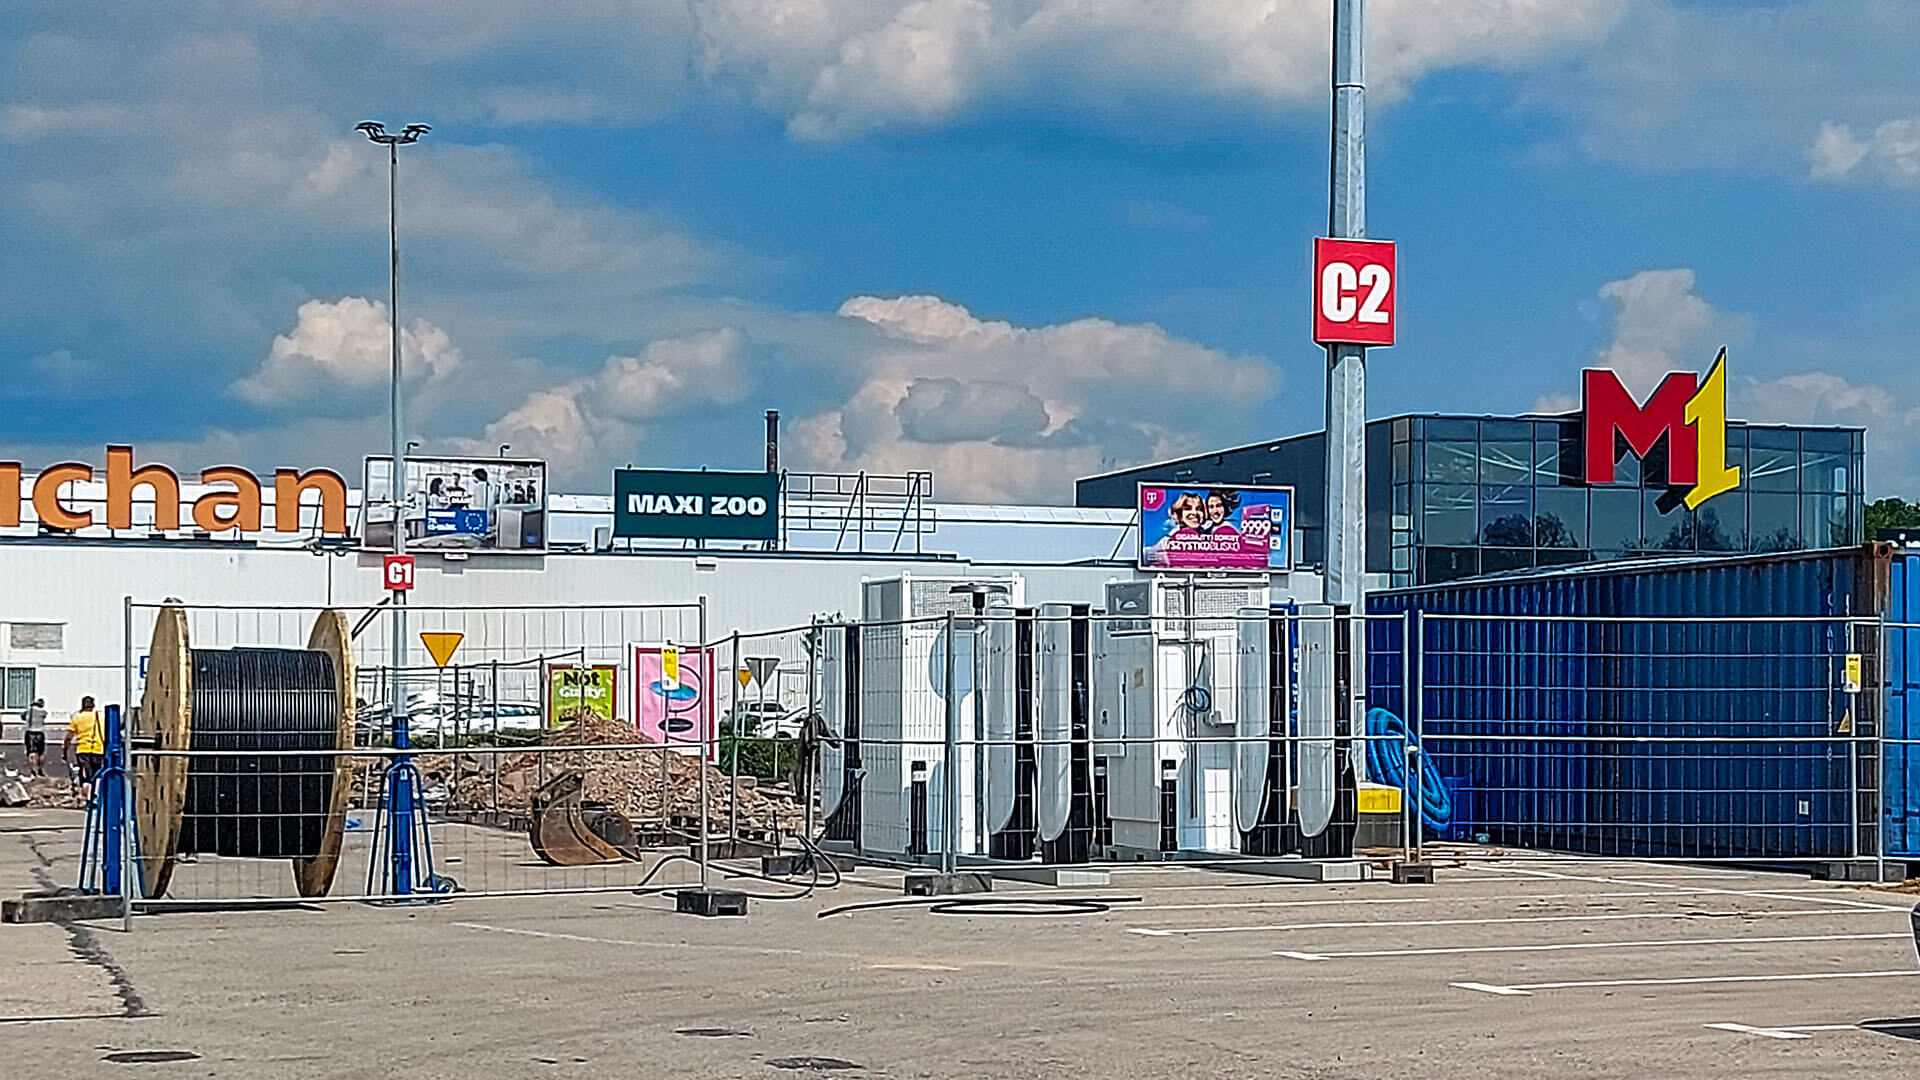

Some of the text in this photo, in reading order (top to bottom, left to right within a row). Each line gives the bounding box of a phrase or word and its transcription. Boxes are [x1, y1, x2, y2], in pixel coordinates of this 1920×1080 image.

[1322, 262, 1390, 323] C2
[1582, 346, 1740, 510] M1
[0, 445, 348, 533] chan
[628, 494, 767, 515] MAXI ZOO
[388, 562, 412, 583] C1
[564, 671, 601, 687] Not
